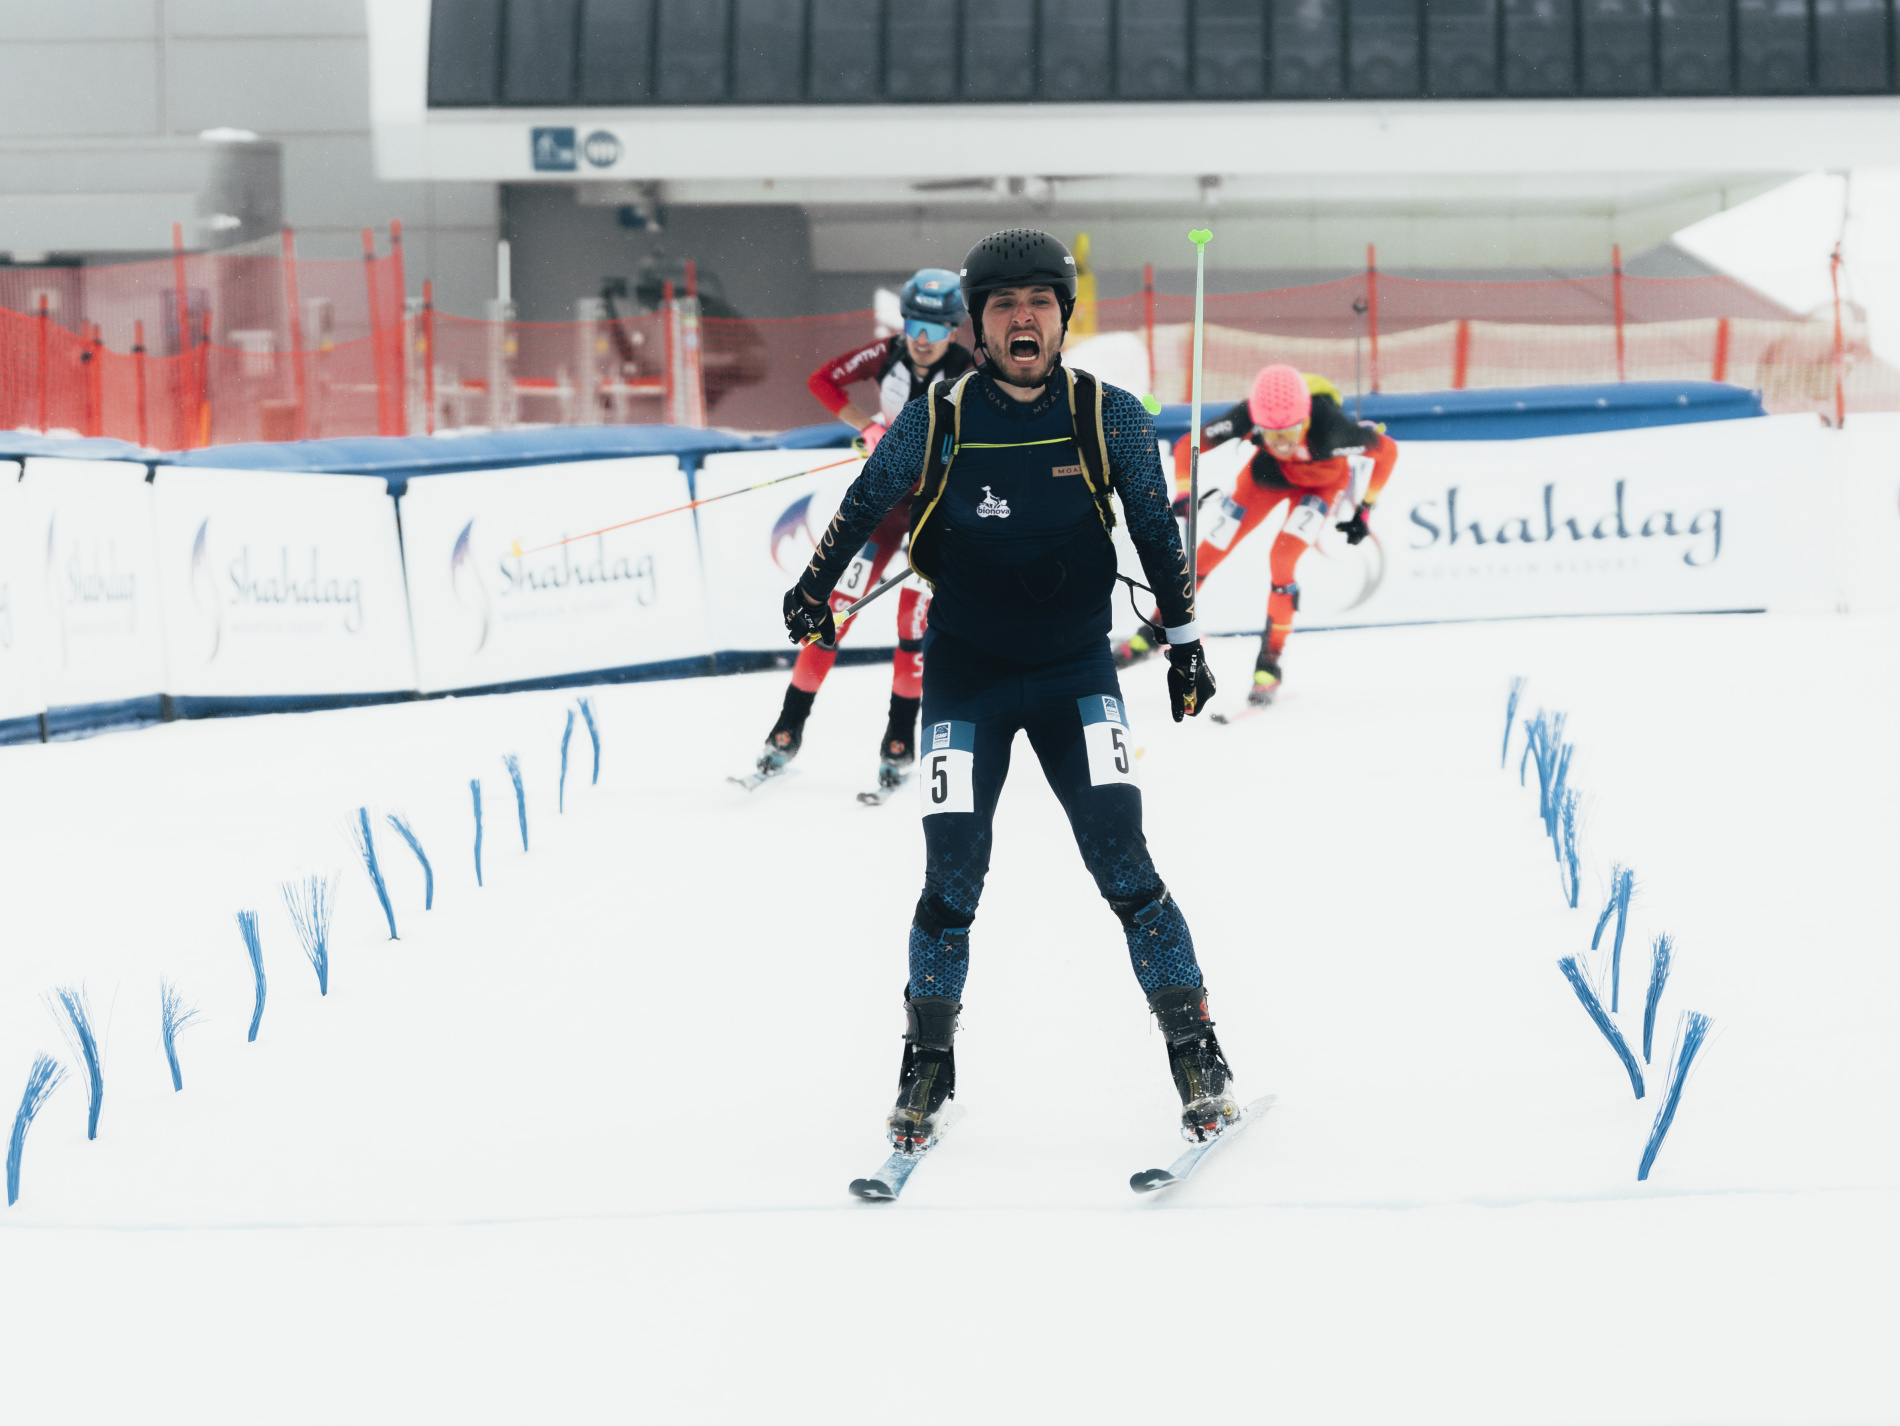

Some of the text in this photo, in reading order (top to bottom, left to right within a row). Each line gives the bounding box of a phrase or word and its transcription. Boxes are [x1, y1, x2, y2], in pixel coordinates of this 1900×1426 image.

[1058, 466, 1081, 474] MOA
[978, 506, 1010, 515] bionova
[1210, 516, 1226, 538] 2
[1298, 510, 1314, 532] 2
[1408, 478, 1724, 568] Shahdag
[499, 530, 657, 607] Shahdag
[228, 545, 364, 634] Shahdag
[1189, 654, 1198, 681] LEKI
[1110, 728, 1130, 774] 5
[931, 755, 948, 804] 5
